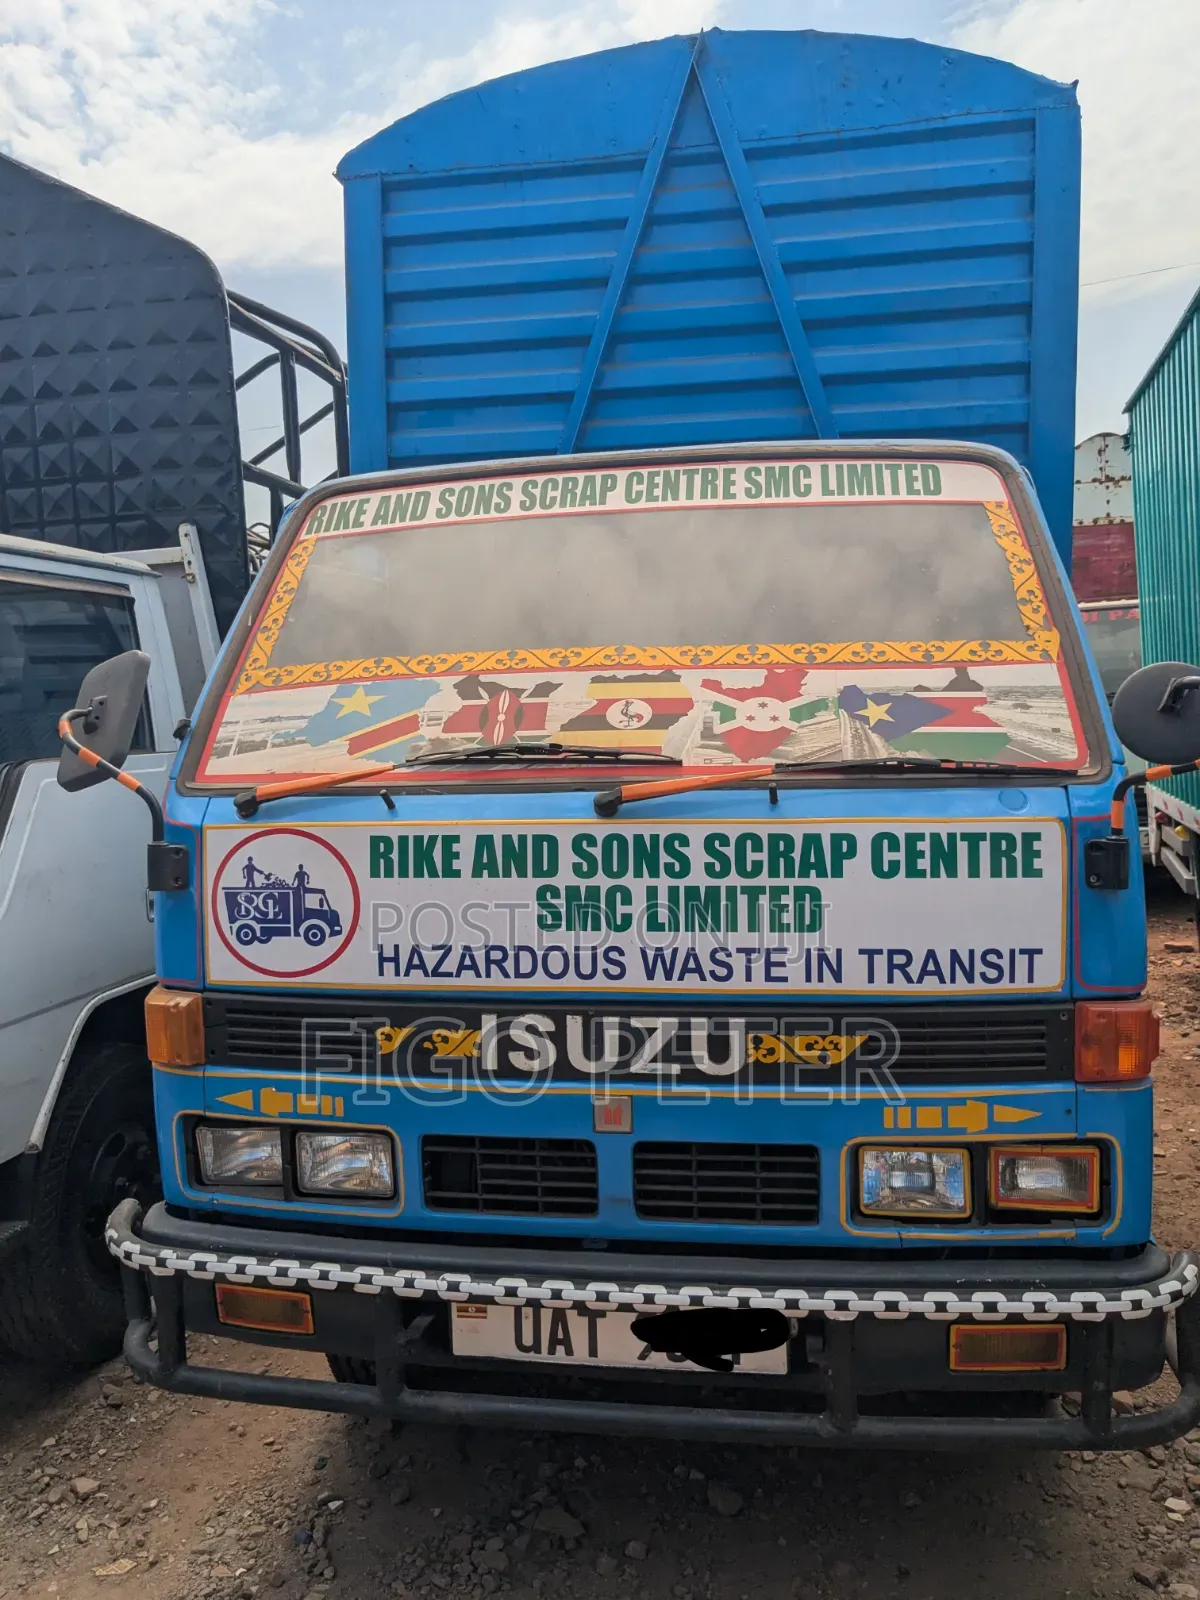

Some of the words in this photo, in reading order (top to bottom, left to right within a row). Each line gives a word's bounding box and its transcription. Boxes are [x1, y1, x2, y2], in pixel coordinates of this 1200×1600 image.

[304, 498, 372, 535] RIKE
[370, 491, 432, 526] AND
[435, 481, 513, 519] SONS
[520, 473, 618, 511] SCRAP
[624, 467, 737, 504] CENTRE
[744, 465, 812, 499] SMC
[820, 464, 942, 496] LIMITED
[369, 835, 461, 879] RIKE
[471, 834, 559, 879] AND
[571, 832, 691, 879] SONS
[703, 832, 858, 879] SCRAP
[870, 832, 1043, 879] CENTRE
[536, 884, 633, 933] SMC
[645, 885, 823, 933] LIMITED
[377, 943, 627, 981] HAZARDOUS
[640, 946, 789, 983] WASTE
[804, 948, 843, 984] IN
[858, 948, 1043, 985] TRANSIT
[481, 1012, 748, 1076] ISUZU
[514, 1304, 607, 1358] UAT
